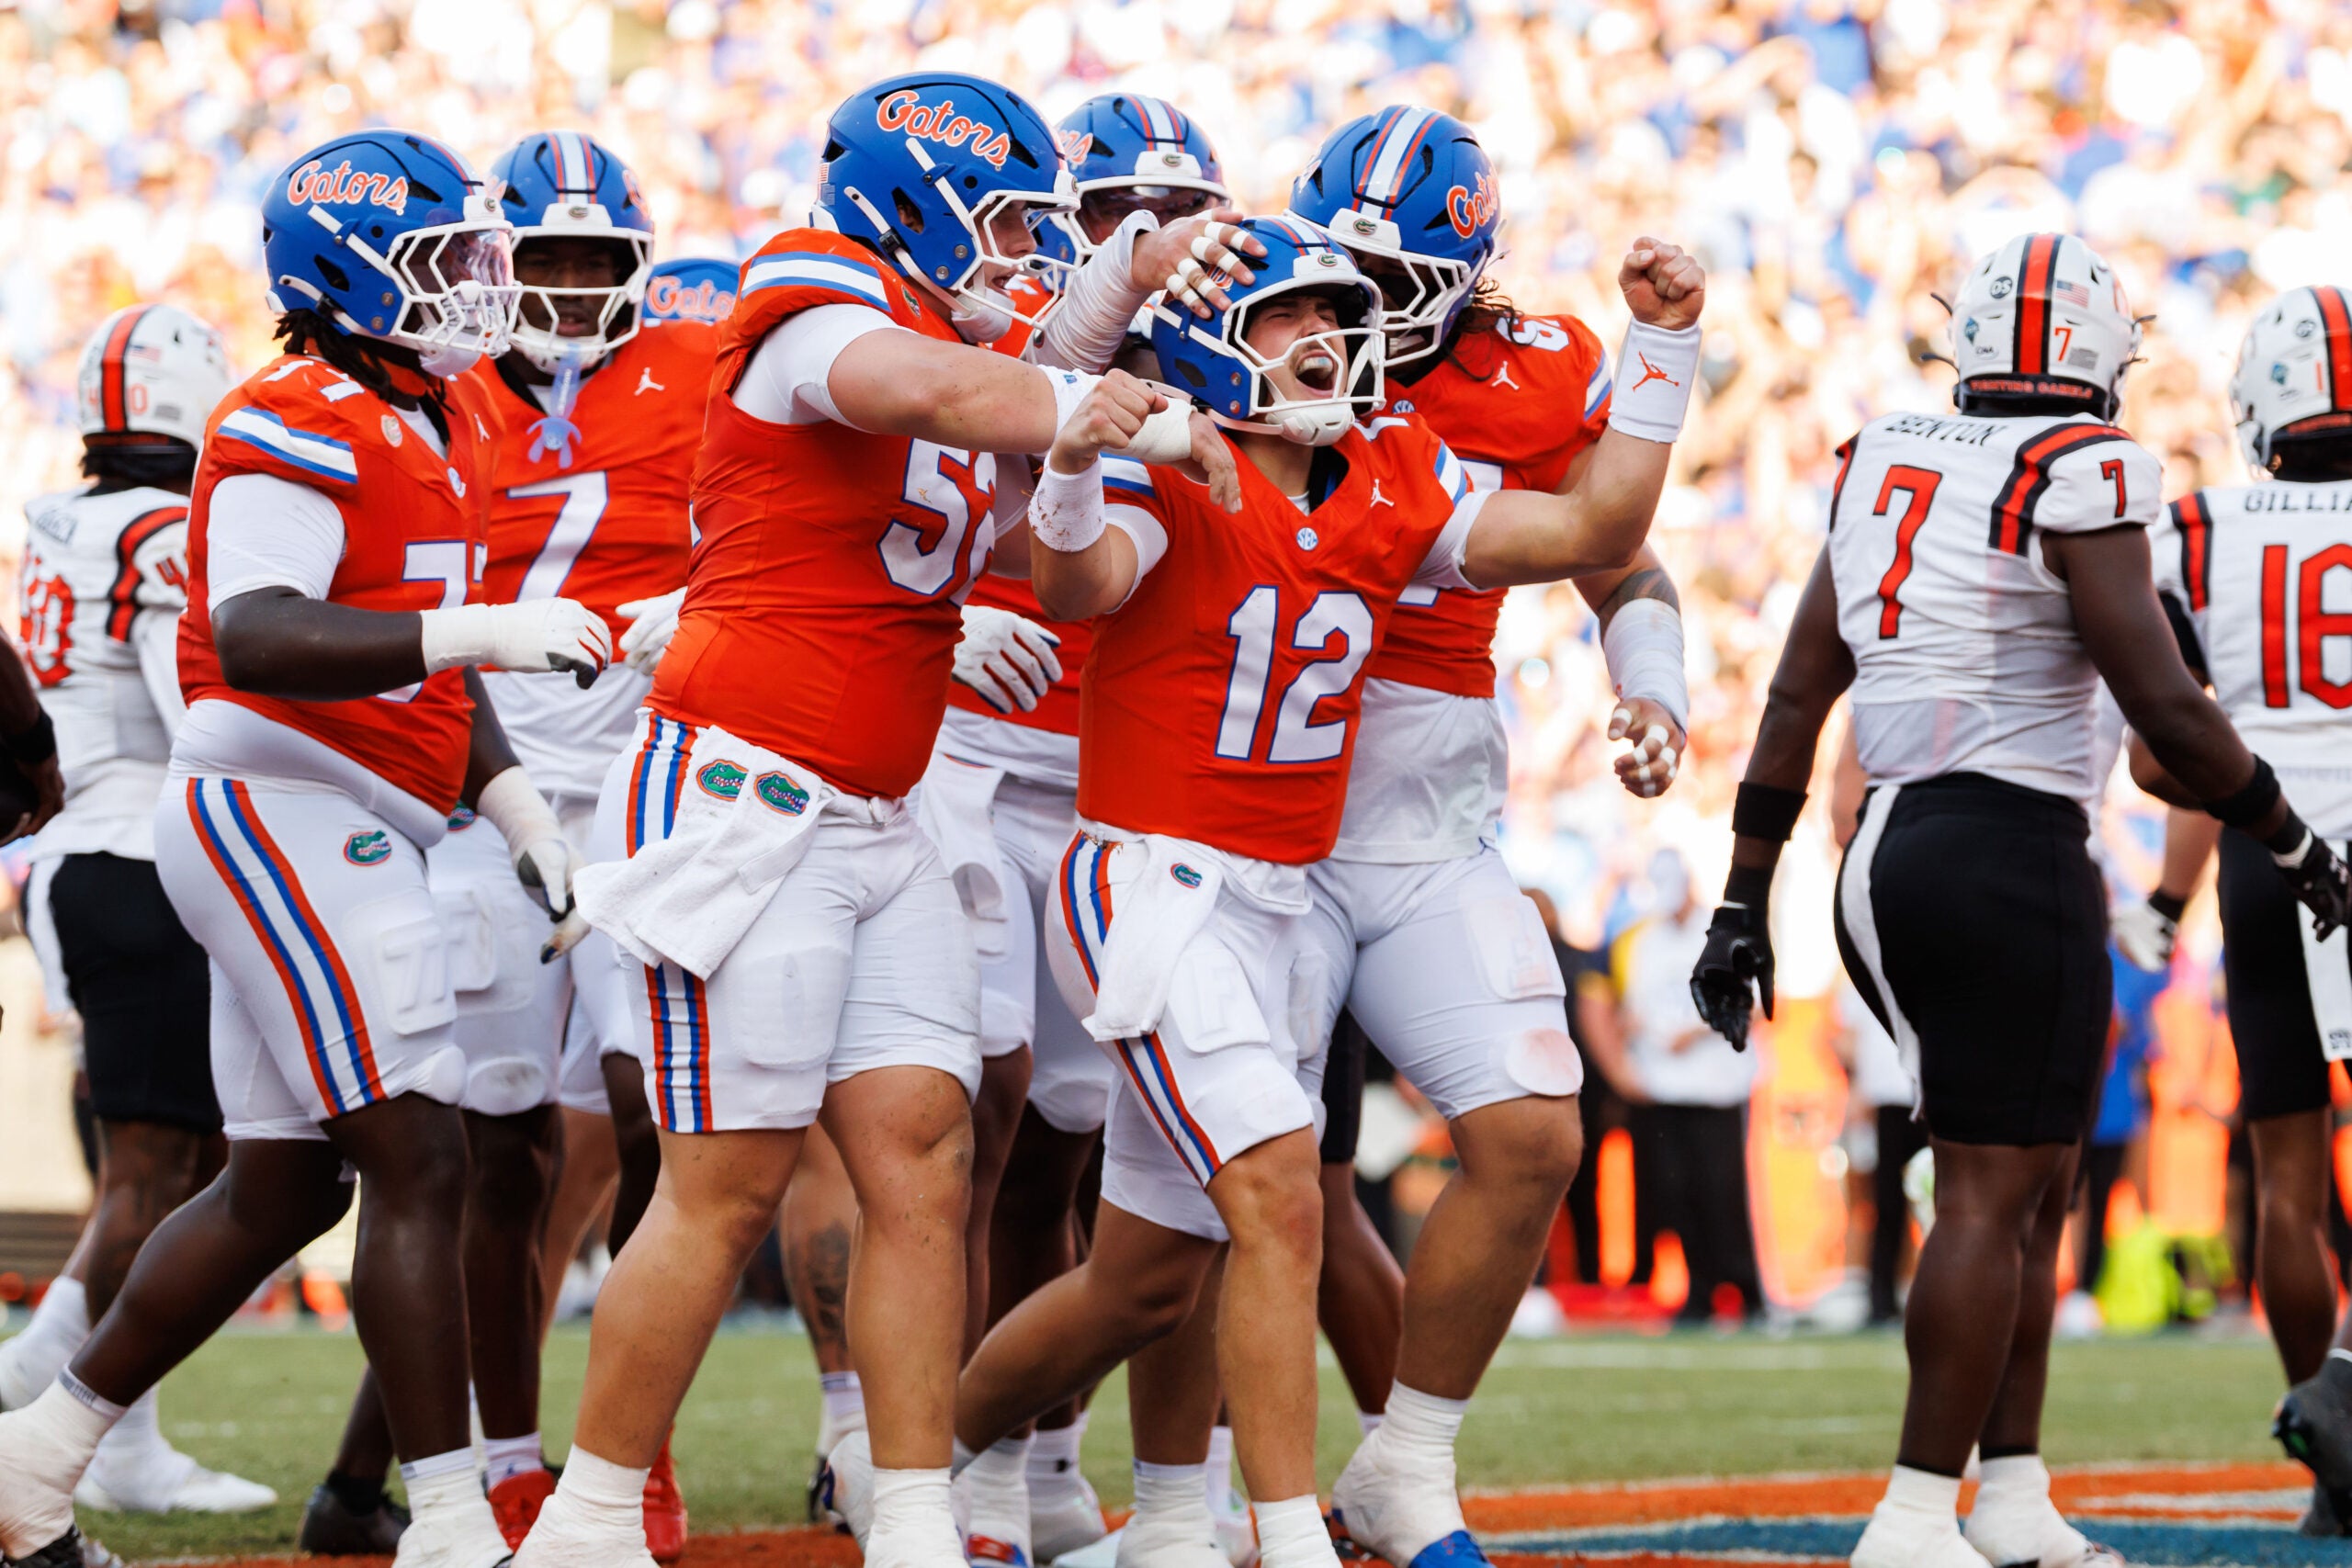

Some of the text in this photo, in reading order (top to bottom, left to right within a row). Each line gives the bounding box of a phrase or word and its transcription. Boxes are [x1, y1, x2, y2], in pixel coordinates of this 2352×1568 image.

[876, 90, 1011, 166] Gators
[288, 160, 409, 211] Gators
[2054, 327, 2072, 362] 7
[2100, 458, 2126, 518] 7
[506, 470, 608, 603] 7
[1872, 465, 1942, 639] 7
[1214, 582, 1374, 764] 12
